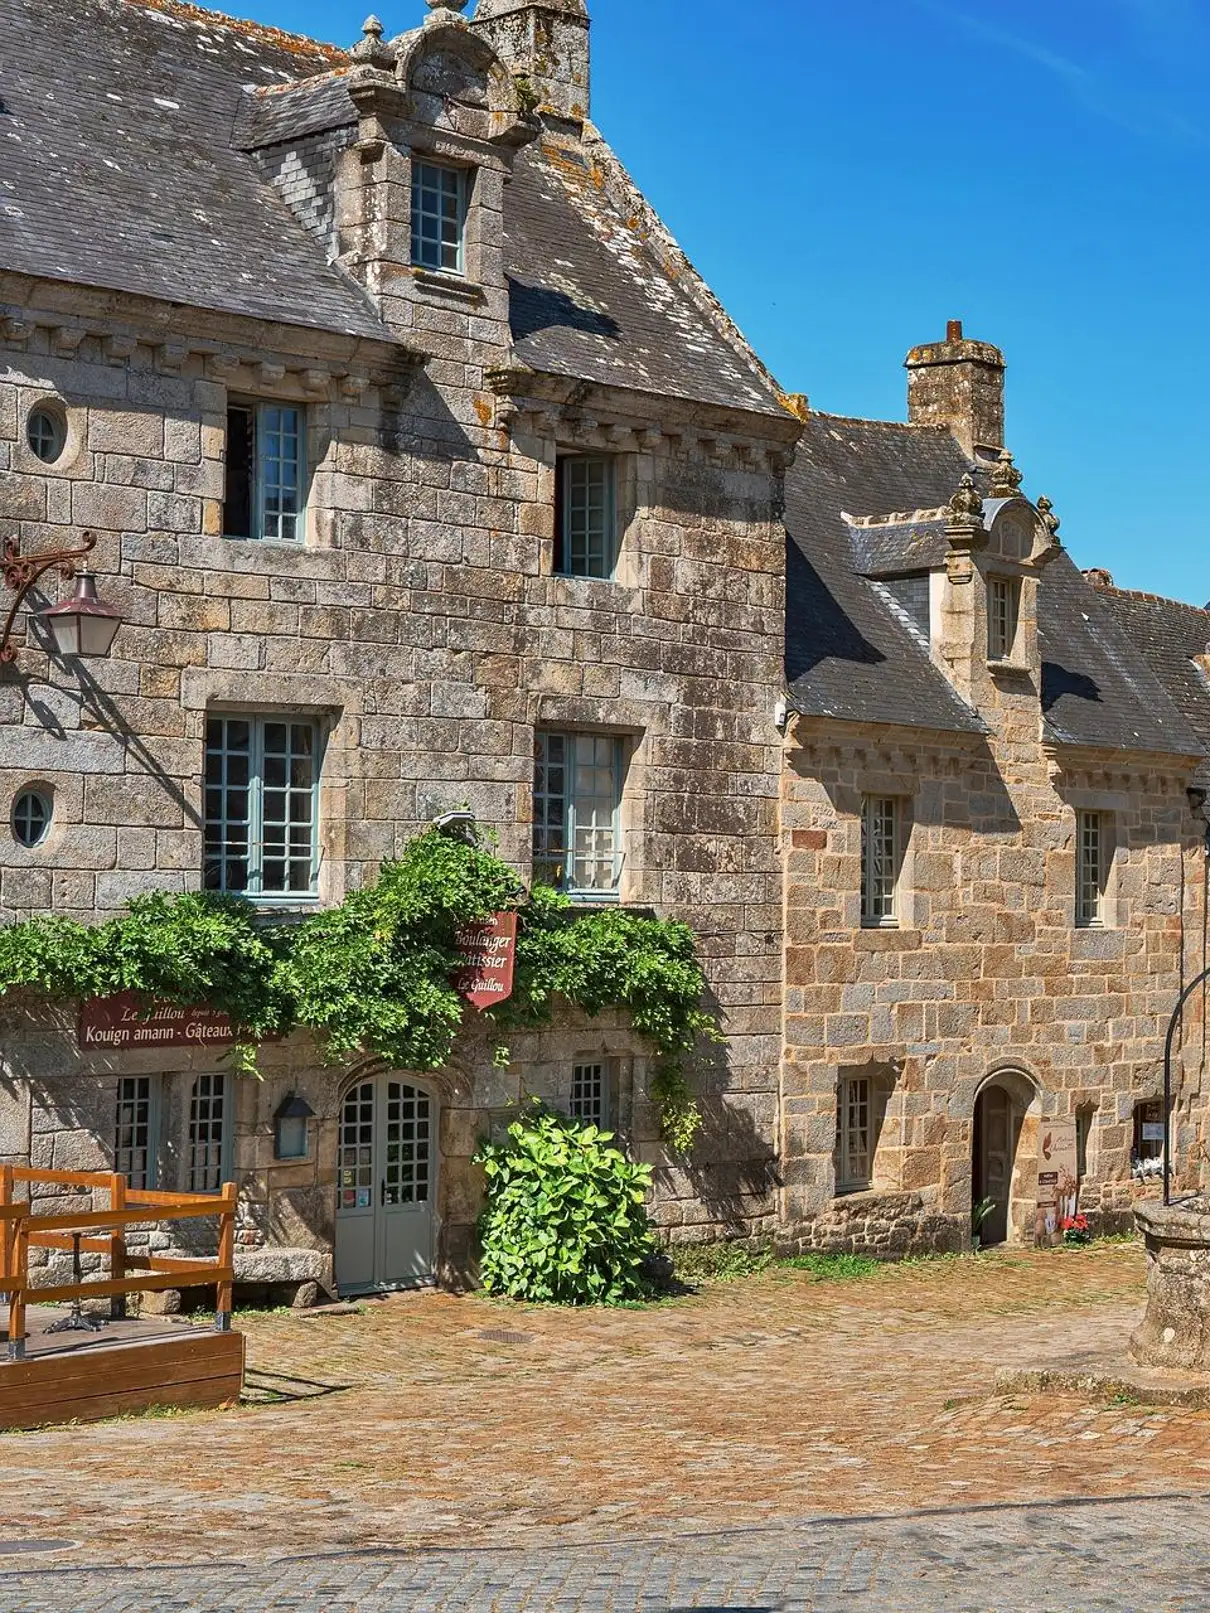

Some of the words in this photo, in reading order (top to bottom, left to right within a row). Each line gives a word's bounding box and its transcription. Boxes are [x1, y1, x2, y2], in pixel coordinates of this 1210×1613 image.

[454, 929, 512, 953] Boulanger
[471, 978, 504, 993] Guillou
[121, 1007, 138, 1021] Le
[86, 1025, 130, 1046] Kouign
[133, 1027, 174, 1040] amann
[185, 1022, 233, 1038] Gâteaux
